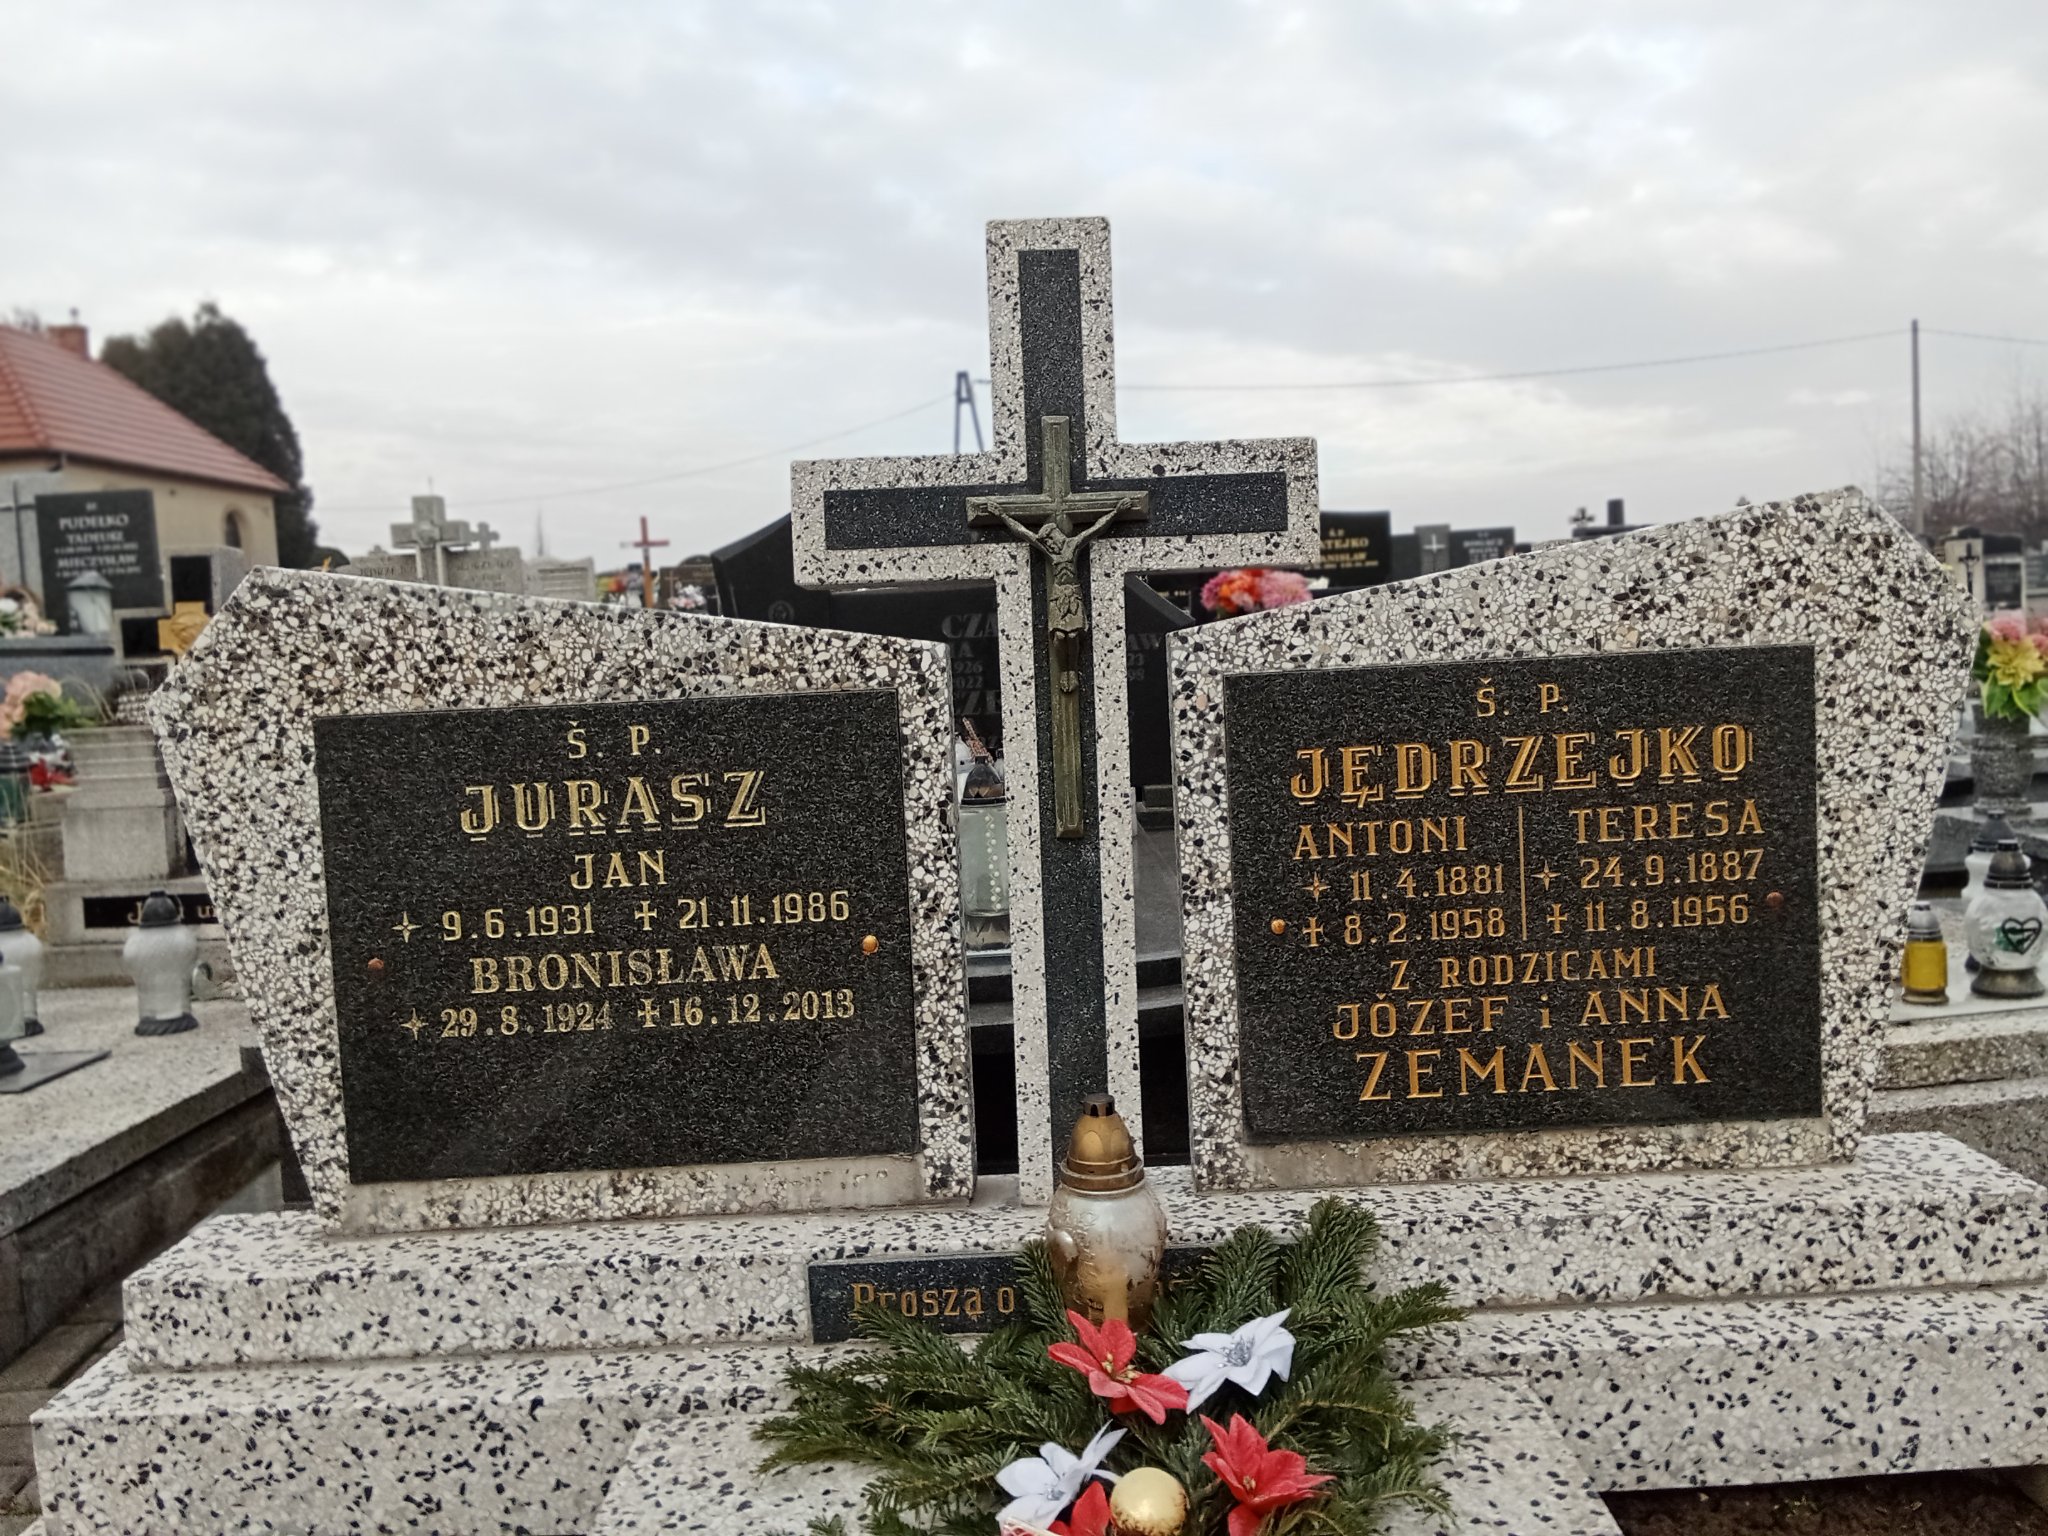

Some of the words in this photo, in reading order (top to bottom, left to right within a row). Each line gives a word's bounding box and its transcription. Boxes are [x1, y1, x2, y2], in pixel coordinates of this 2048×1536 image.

[1537, 682, 1569, 713] P.
[627, 725, 661, 756] P.
[1290, 723, 1754, 808] JĘDRZEJKO
[460, 770, 766, 842] JURASZ
[1569, 799, 1766, 844] TERESA
[1293, 815, 1468, 860] ANTONI
[570, 850, 667, 890] JAN
[471, 942, 780, 994] BRONISŁAWA
[1390, 960, 1410, 990] Z
[1440, 946, 1656, 988] RODZICAMI
[1540, 995, 1552, 1028] i
[1579, 983, 1730, 1027] ANNA
[1355, 1034, 1711, 1102] ZEMANEK
[998, 1286, 1014, 1313] o
